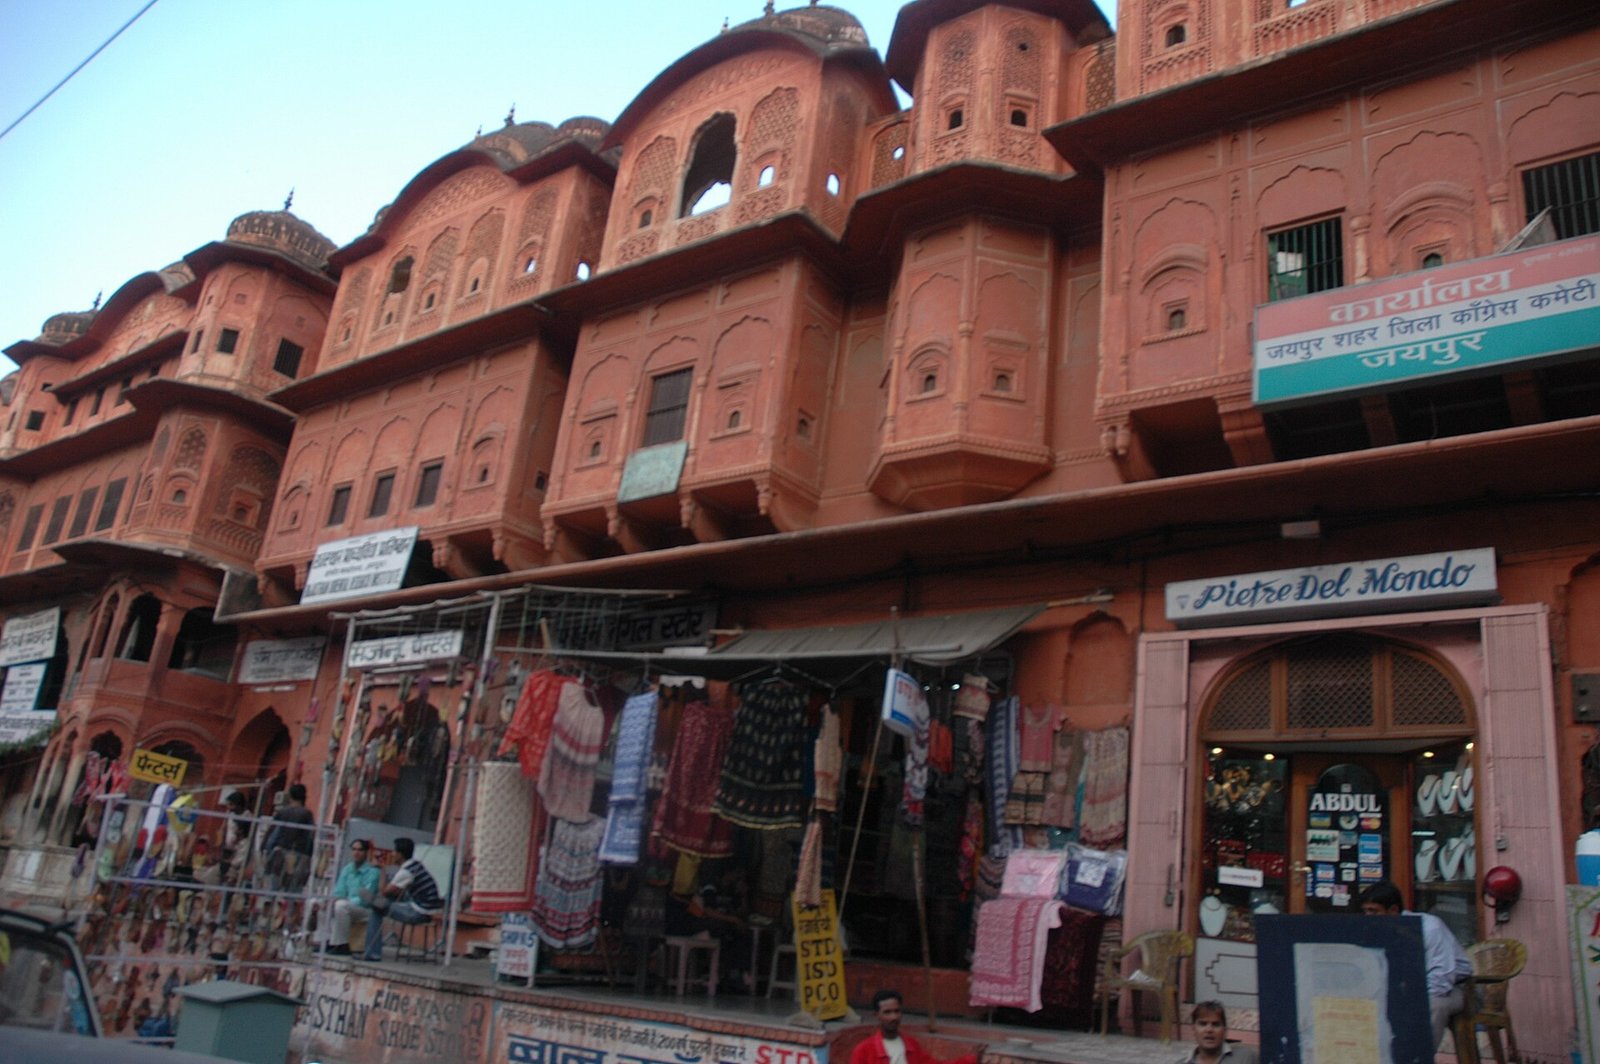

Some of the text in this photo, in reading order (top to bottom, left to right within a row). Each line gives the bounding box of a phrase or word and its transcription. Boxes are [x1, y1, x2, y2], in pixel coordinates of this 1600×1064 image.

[1329, 270, 1512, 323] कार्यालय
[1266, 337, 1324, 361] जयपुर
[1333, 326, 1380, 347] शहर
[1389, 313, 1441, 340] जिला
[1528, 279, 1597, 309] कमेटी
[1358, 331, 1489, 368] जयपुर
[1193, 556, 1477, 610] Pietre Del Mondo
[1309, 793, 1382, 812] ABDUL
[801, 938, 836, 957] STD
[804, 962, 837, 980] ISD
[805, 982, 839, 1004] PCO
